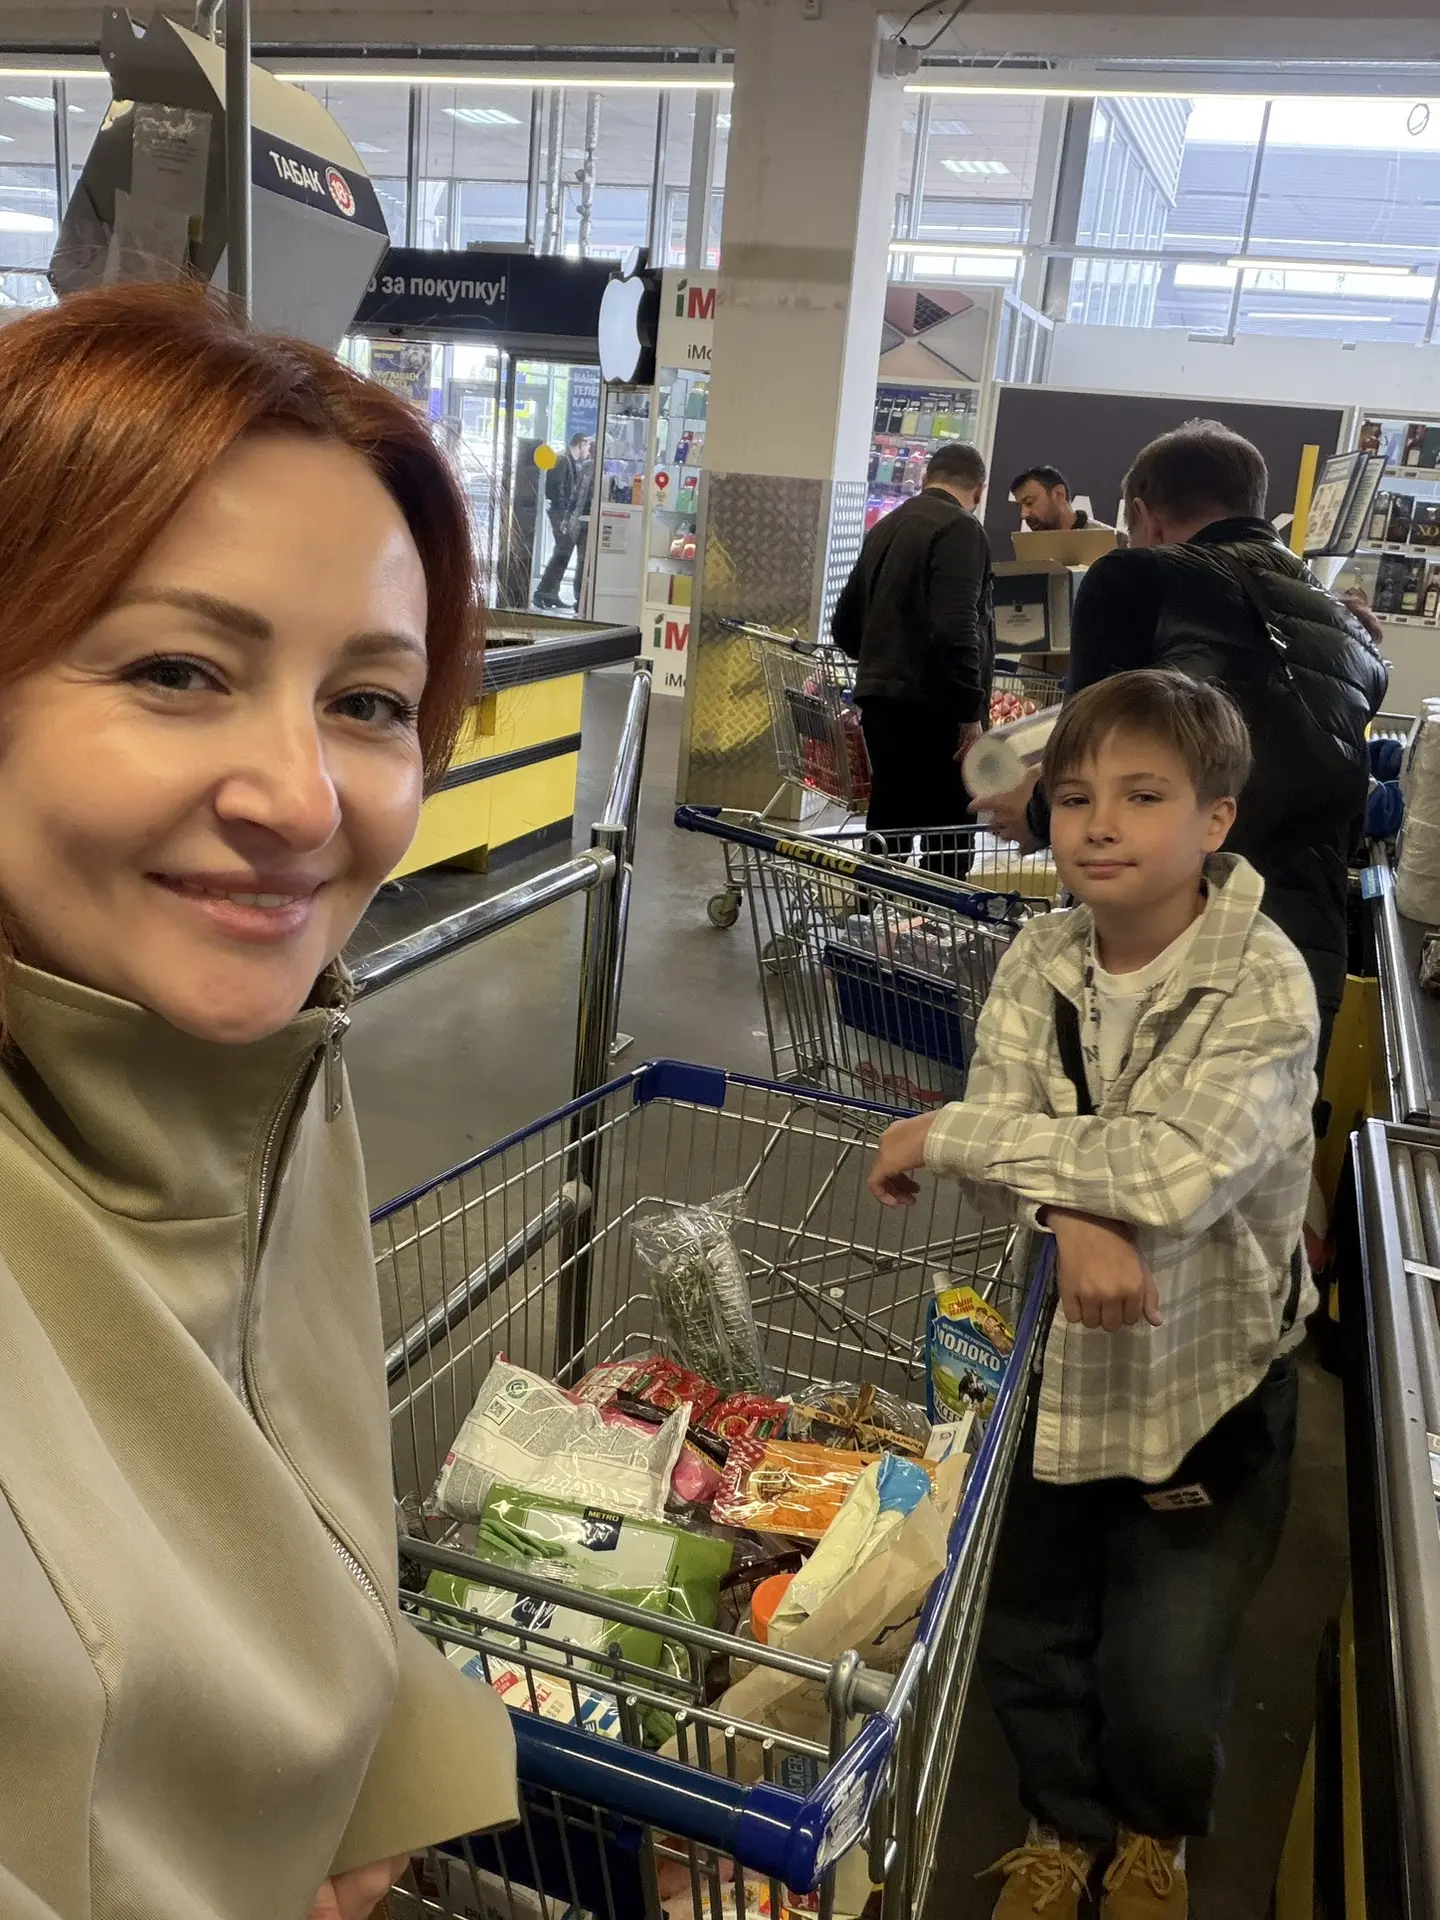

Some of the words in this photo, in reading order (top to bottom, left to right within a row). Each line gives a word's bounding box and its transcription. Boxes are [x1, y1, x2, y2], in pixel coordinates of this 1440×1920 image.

[268, 150, 326, 195] ТАБАК
[381, 276, 405, 294] за
[410, 275, 506, 305] покупку!
[665, 672, 687, 688] iM
[775, 839, 858, 874] METRO
[936, 1325, 1000, 1372] МОЛОКО
[588, 1510, 620, 1522] METRO
